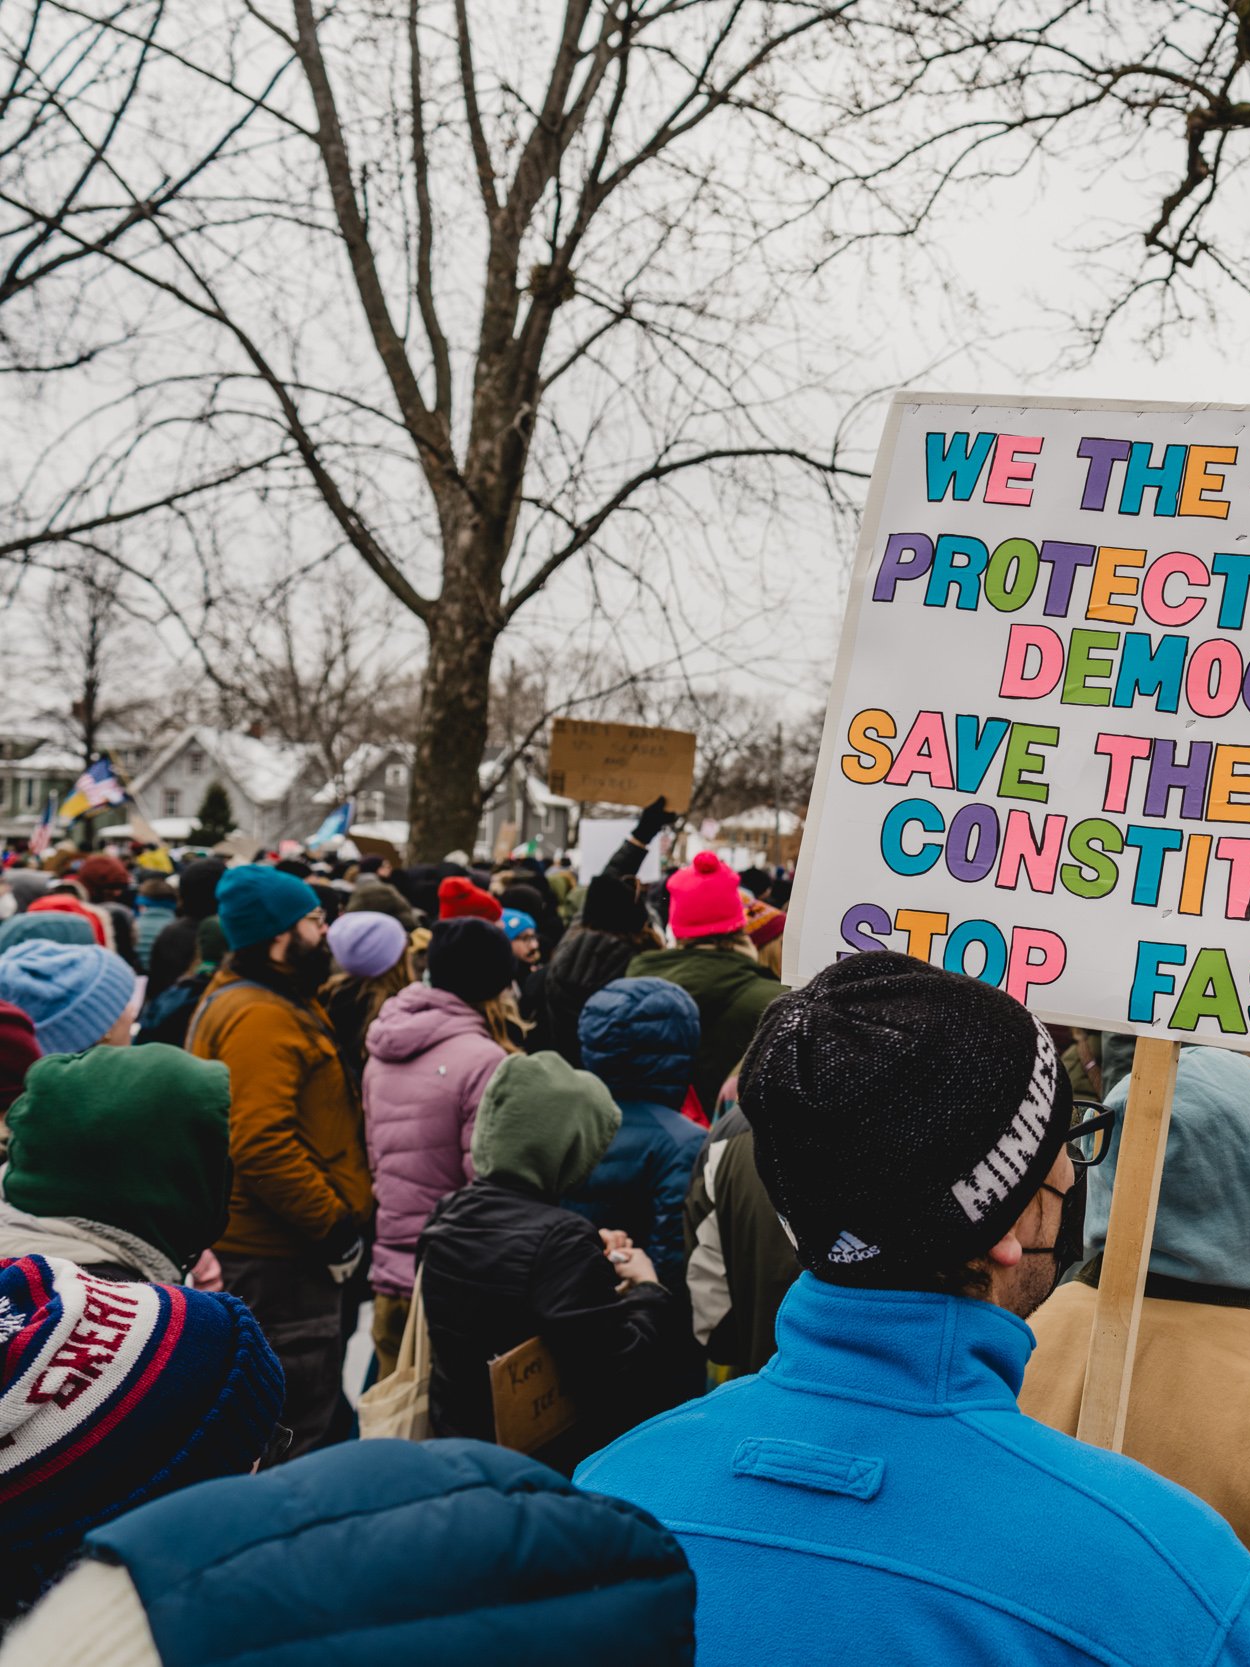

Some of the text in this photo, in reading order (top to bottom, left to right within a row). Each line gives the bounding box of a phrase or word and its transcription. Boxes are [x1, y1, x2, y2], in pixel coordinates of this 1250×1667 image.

[925, 431, 1045, 507] WE
[1076, 437, 1237, 519] THE
[840, 708, 1059, 802] SAVE
[837, 902, 1067, 1006] STOP
[828, 1245, 880, 1263] adidas
